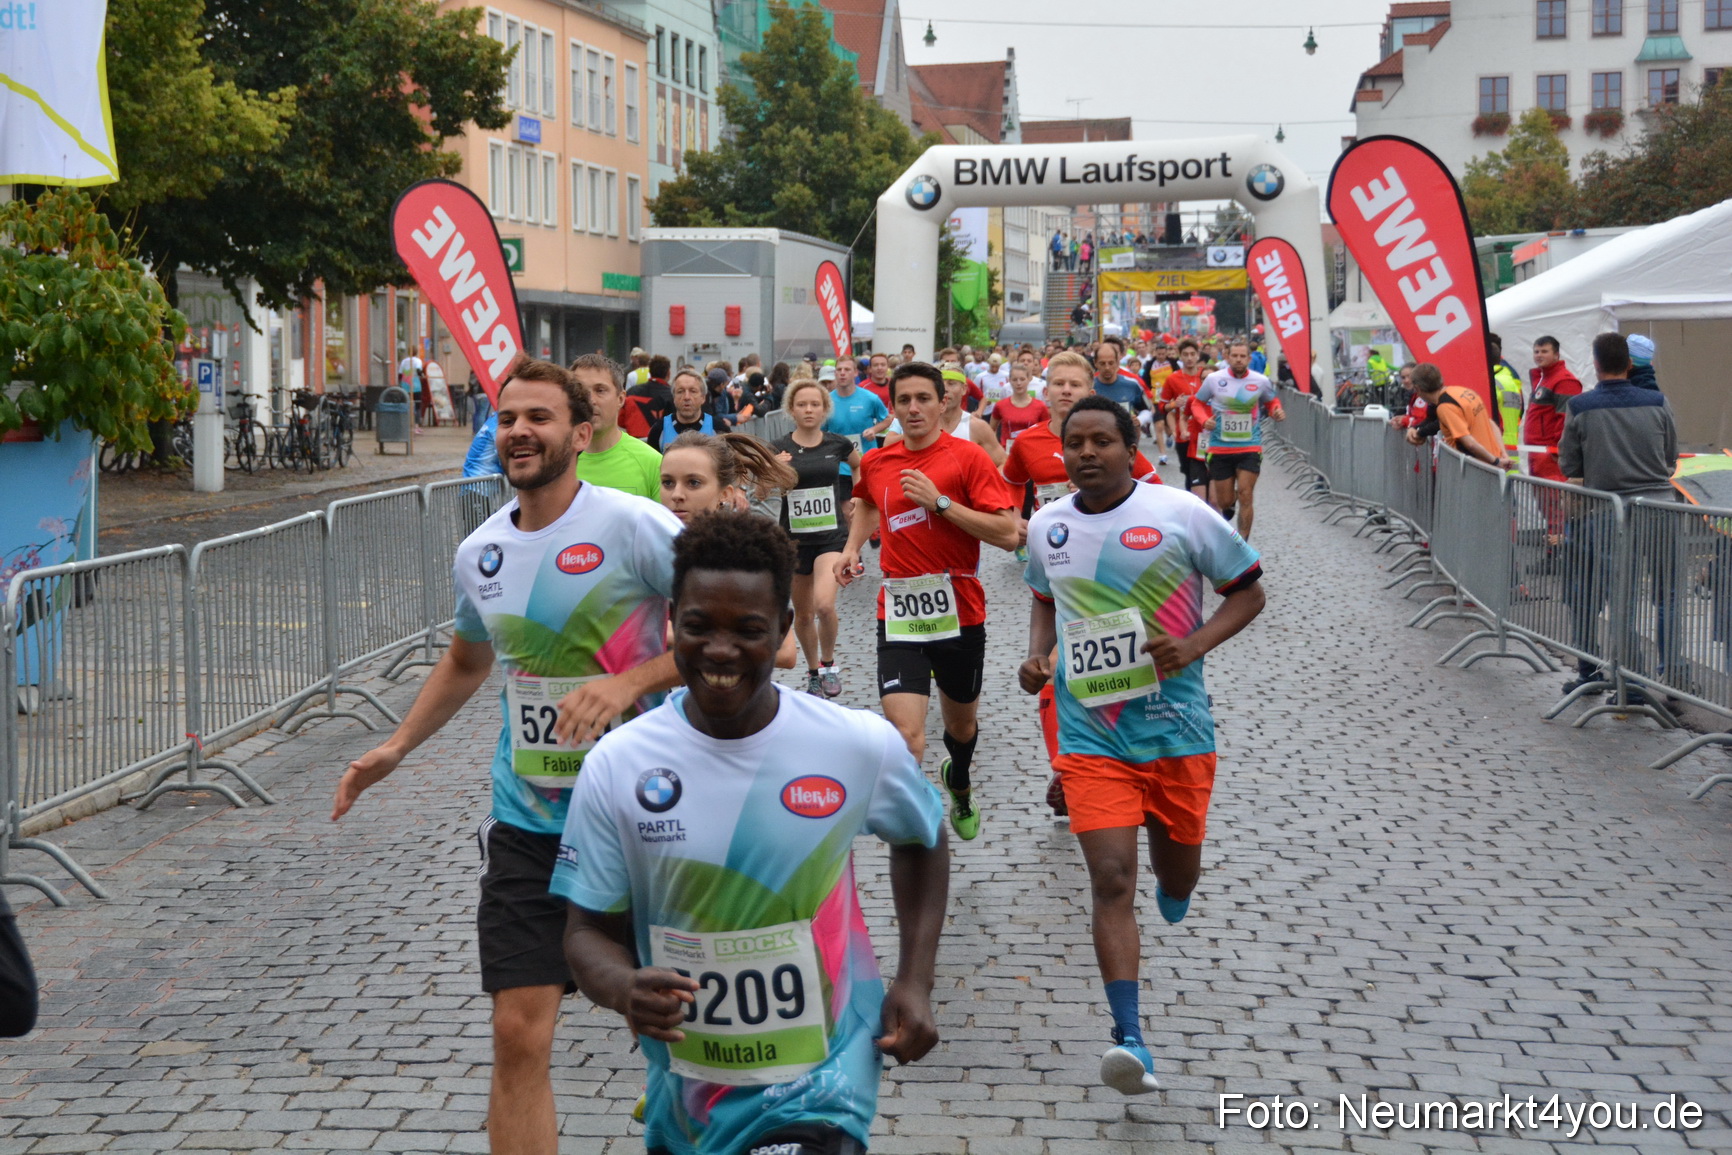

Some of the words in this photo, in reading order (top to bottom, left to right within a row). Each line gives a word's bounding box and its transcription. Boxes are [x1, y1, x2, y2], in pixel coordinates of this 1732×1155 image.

[954, 157, 1049, 185] BMW
[1060, 152, 1232, 187] Laufsport
[1157, 274, 1189, 287] ZIEL
[201, 366, 210, 381] P
[1224, 421, 1249, 431] 5317
[793, 498, 831, 516] 5400
[899, 513, 917, 524] DEHN
[1125, 532, 1157, 544] Hervis
[561, 550, 598, 566] Hervis
[1048, 551, 1070, 561] PARTL
[478, 581, 503, 594] PARTL
[894, 589, 949, 618] 5089
[908, 621, 937, 633] Stefan
[1088, 612, 1133, 630] BOCK
[1071, 631, 1137, 674] 5257
[1086, 677, 1132, 694] Weiday
[790, 786, 839, 807] Hervis
[637, 819, 686, 834] PARTL
[641, 832, 686, 843] Neumarkt
[714, 929, 798, 956] BOCK
[703, 1040, 777, 1064] Mutala
